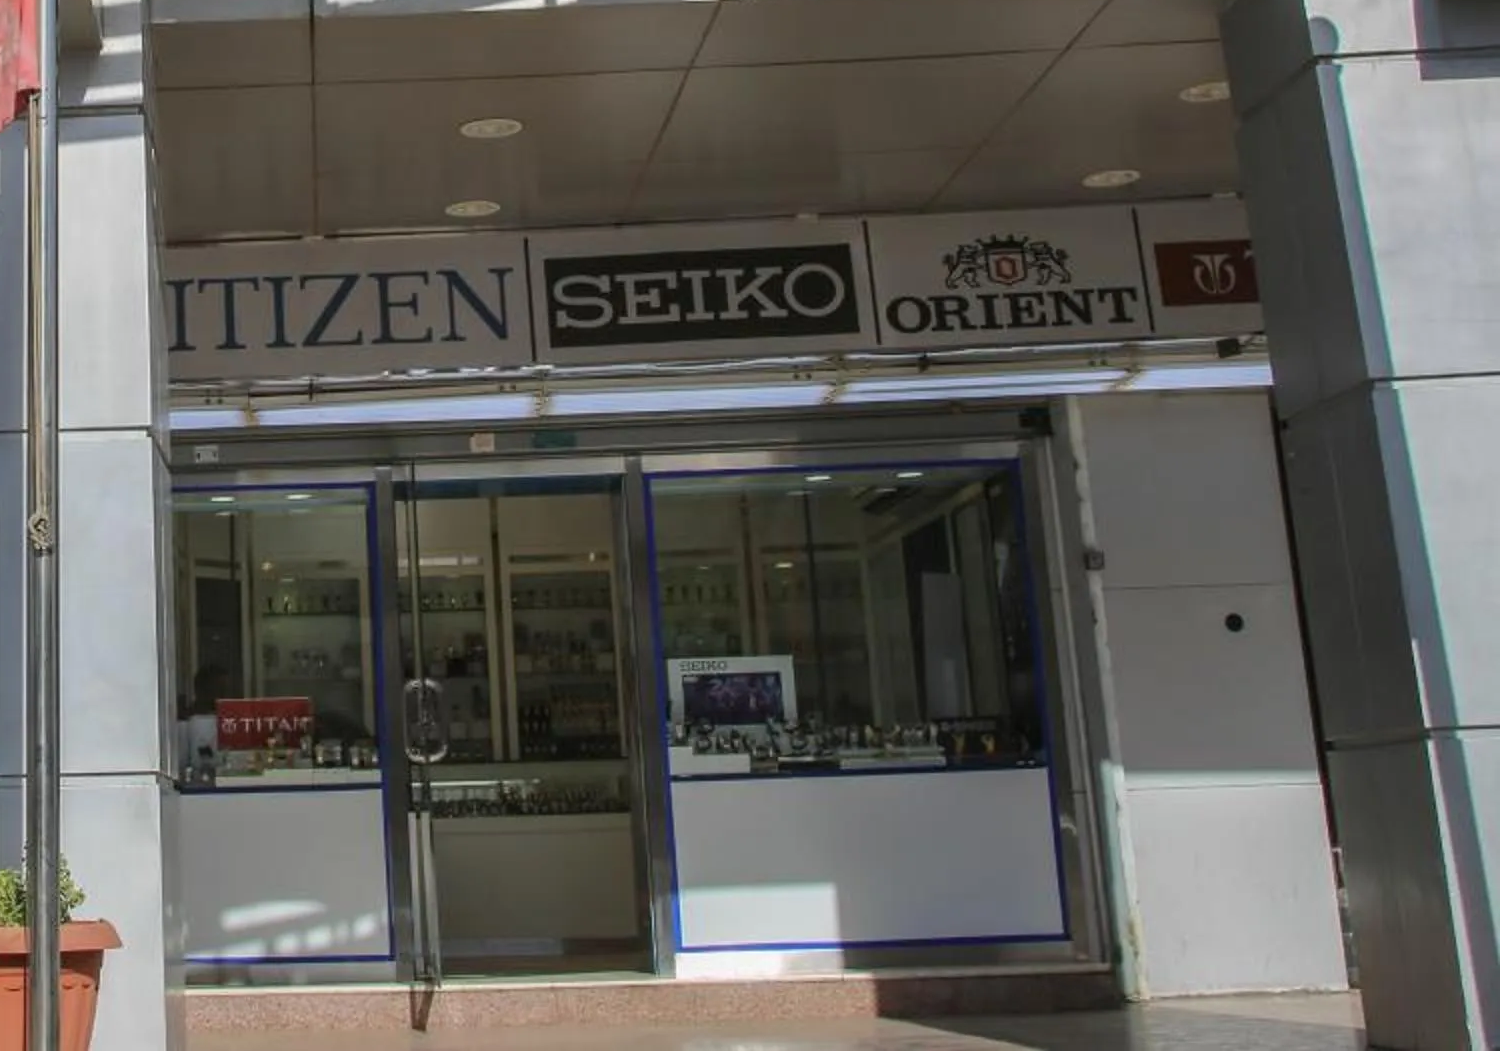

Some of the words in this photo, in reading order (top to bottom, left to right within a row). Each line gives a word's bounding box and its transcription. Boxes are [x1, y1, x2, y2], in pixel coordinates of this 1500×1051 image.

[165, 267, 514, 352] ITIZEN
[553, 262, 845, 329] SEIKO
[885, 286, 1138, 334] ORIENT
[679, 660, 728, 672] SEIKO
